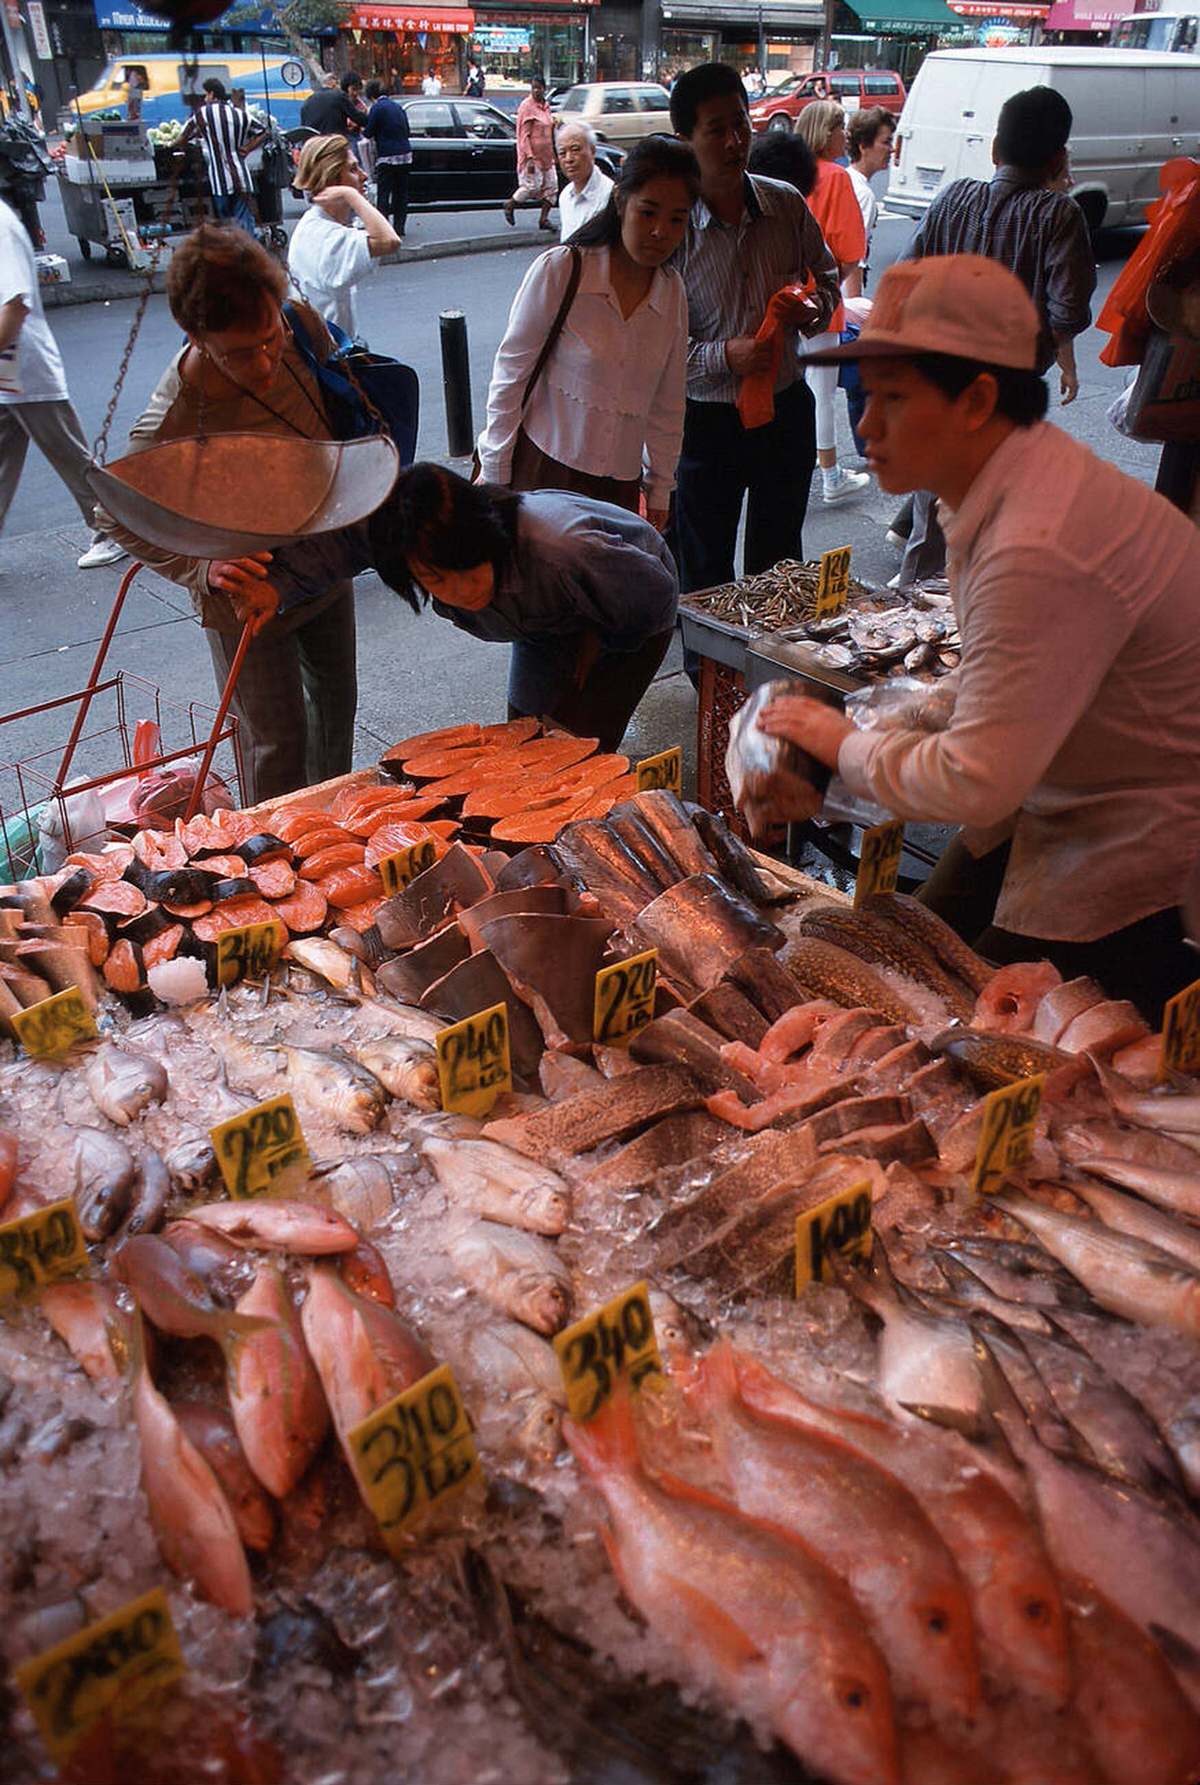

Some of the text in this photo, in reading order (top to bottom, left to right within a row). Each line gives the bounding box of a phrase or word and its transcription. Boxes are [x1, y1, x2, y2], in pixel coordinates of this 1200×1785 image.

[823, 551, 850, 598] 120
[599, 957, 656, 1043] 220
[441, 1013, 506, 1099] 240
[223, 1105, 294, 1199] 220
[562, 1296, 650, 1420] 340
[362, 1384, 458, 1529] 340
